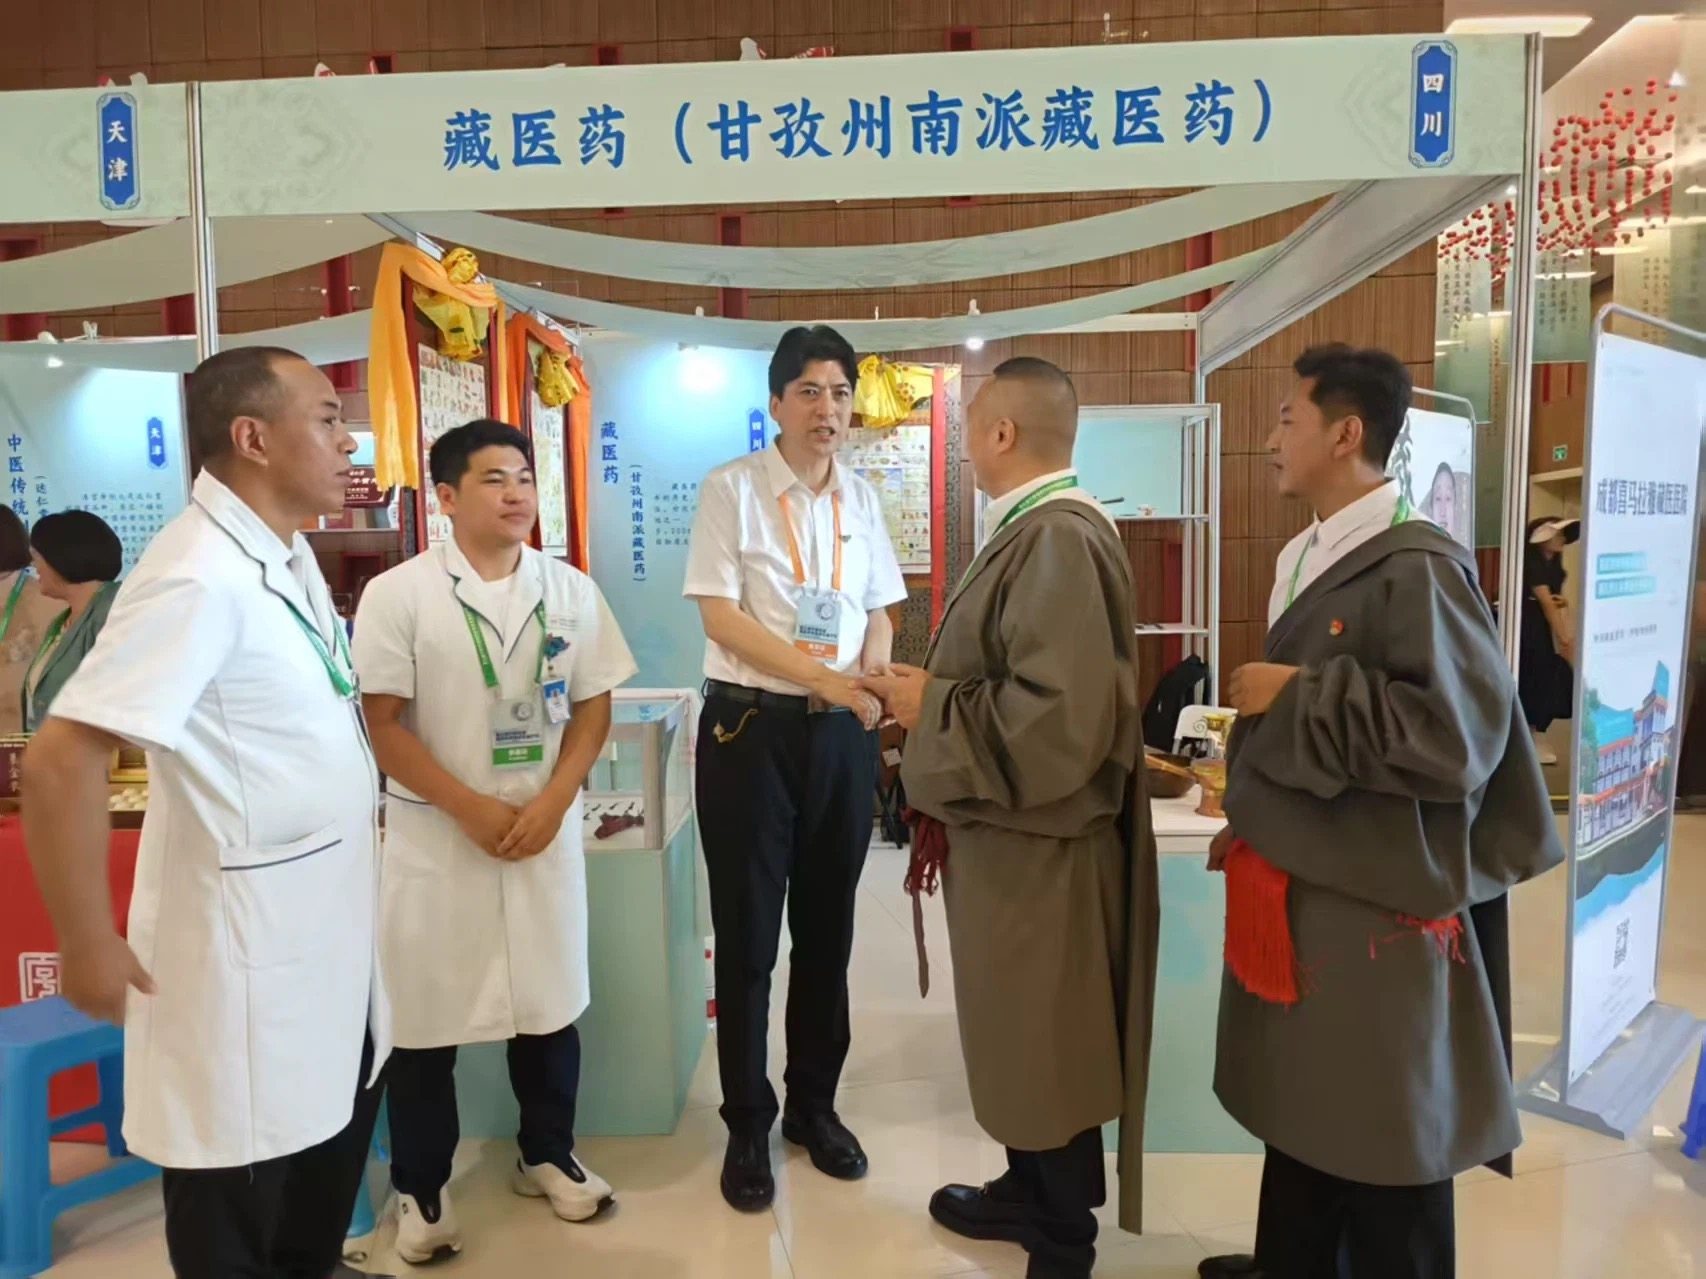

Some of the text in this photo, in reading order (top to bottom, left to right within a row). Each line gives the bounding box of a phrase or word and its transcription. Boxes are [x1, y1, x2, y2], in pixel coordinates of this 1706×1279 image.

[443, 78, 1272, 172] 藏医药（甘孜州南派藏医药）
[1422, 73, 1443, 137] 四川
[106, 118, 128, 183] 天津
[600, 421, 619, 484] 藏医药
